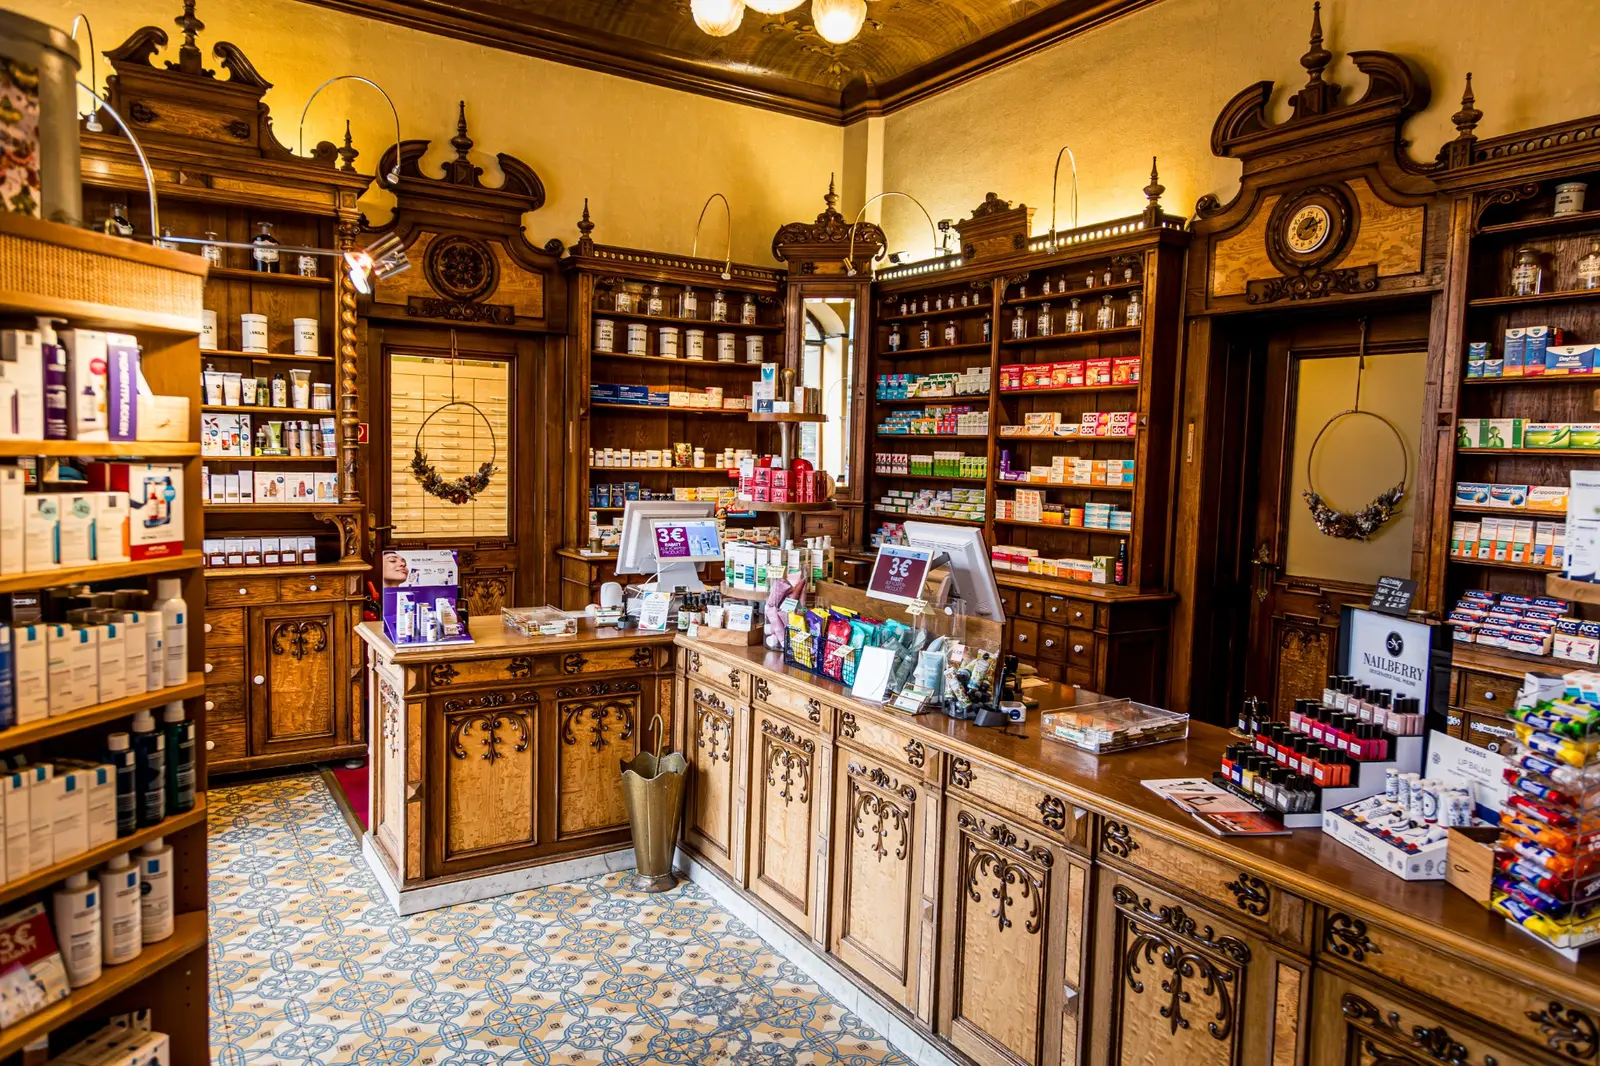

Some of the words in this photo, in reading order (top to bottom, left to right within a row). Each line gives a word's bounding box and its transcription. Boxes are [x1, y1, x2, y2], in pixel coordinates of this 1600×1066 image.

[1084, 414, 1096, 422] doc
[1114, 414, 1128, 422] doc
[1081, 426, 1094, 434] doc
[1112, 426, 1126, 434] doc
[1532, 488, 1565, 496] Grippostad
[1557, 622, 1576, 630] ACC
[1579, 624, 1599, 633] ACC
[1363, 652, 1425, 681] NAILBERRY
[1464, 746, 1487, 759] KORRES
[1468, 761, 1492, 777] BALMS
